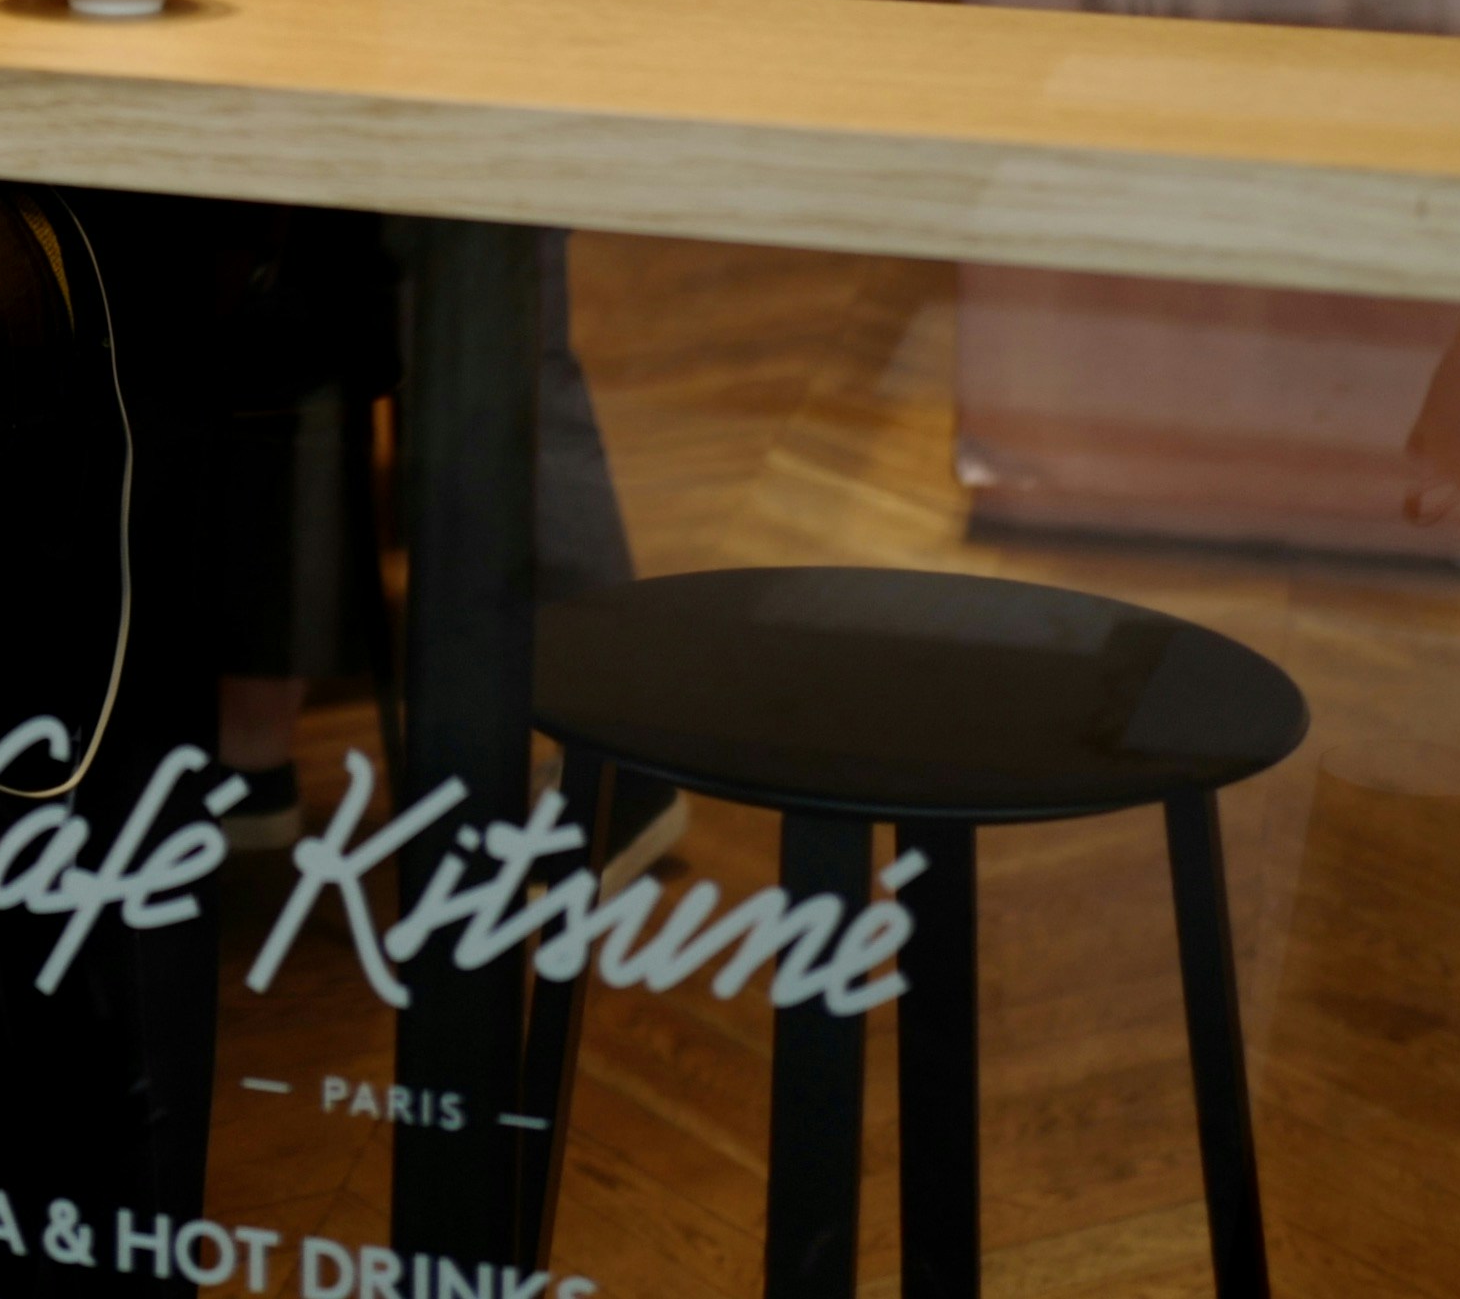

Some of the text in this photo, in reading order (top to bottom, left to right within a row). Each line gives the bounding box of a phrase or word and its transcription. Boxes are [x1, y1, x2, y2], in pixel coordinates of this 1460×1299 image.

[244, 747, 929, 1018] Kitsuné
[321, 1075, 466, 1132] PARIS
[42, 1198, 96, 1267] &
[116, 1209, 280, 1293] HOT
